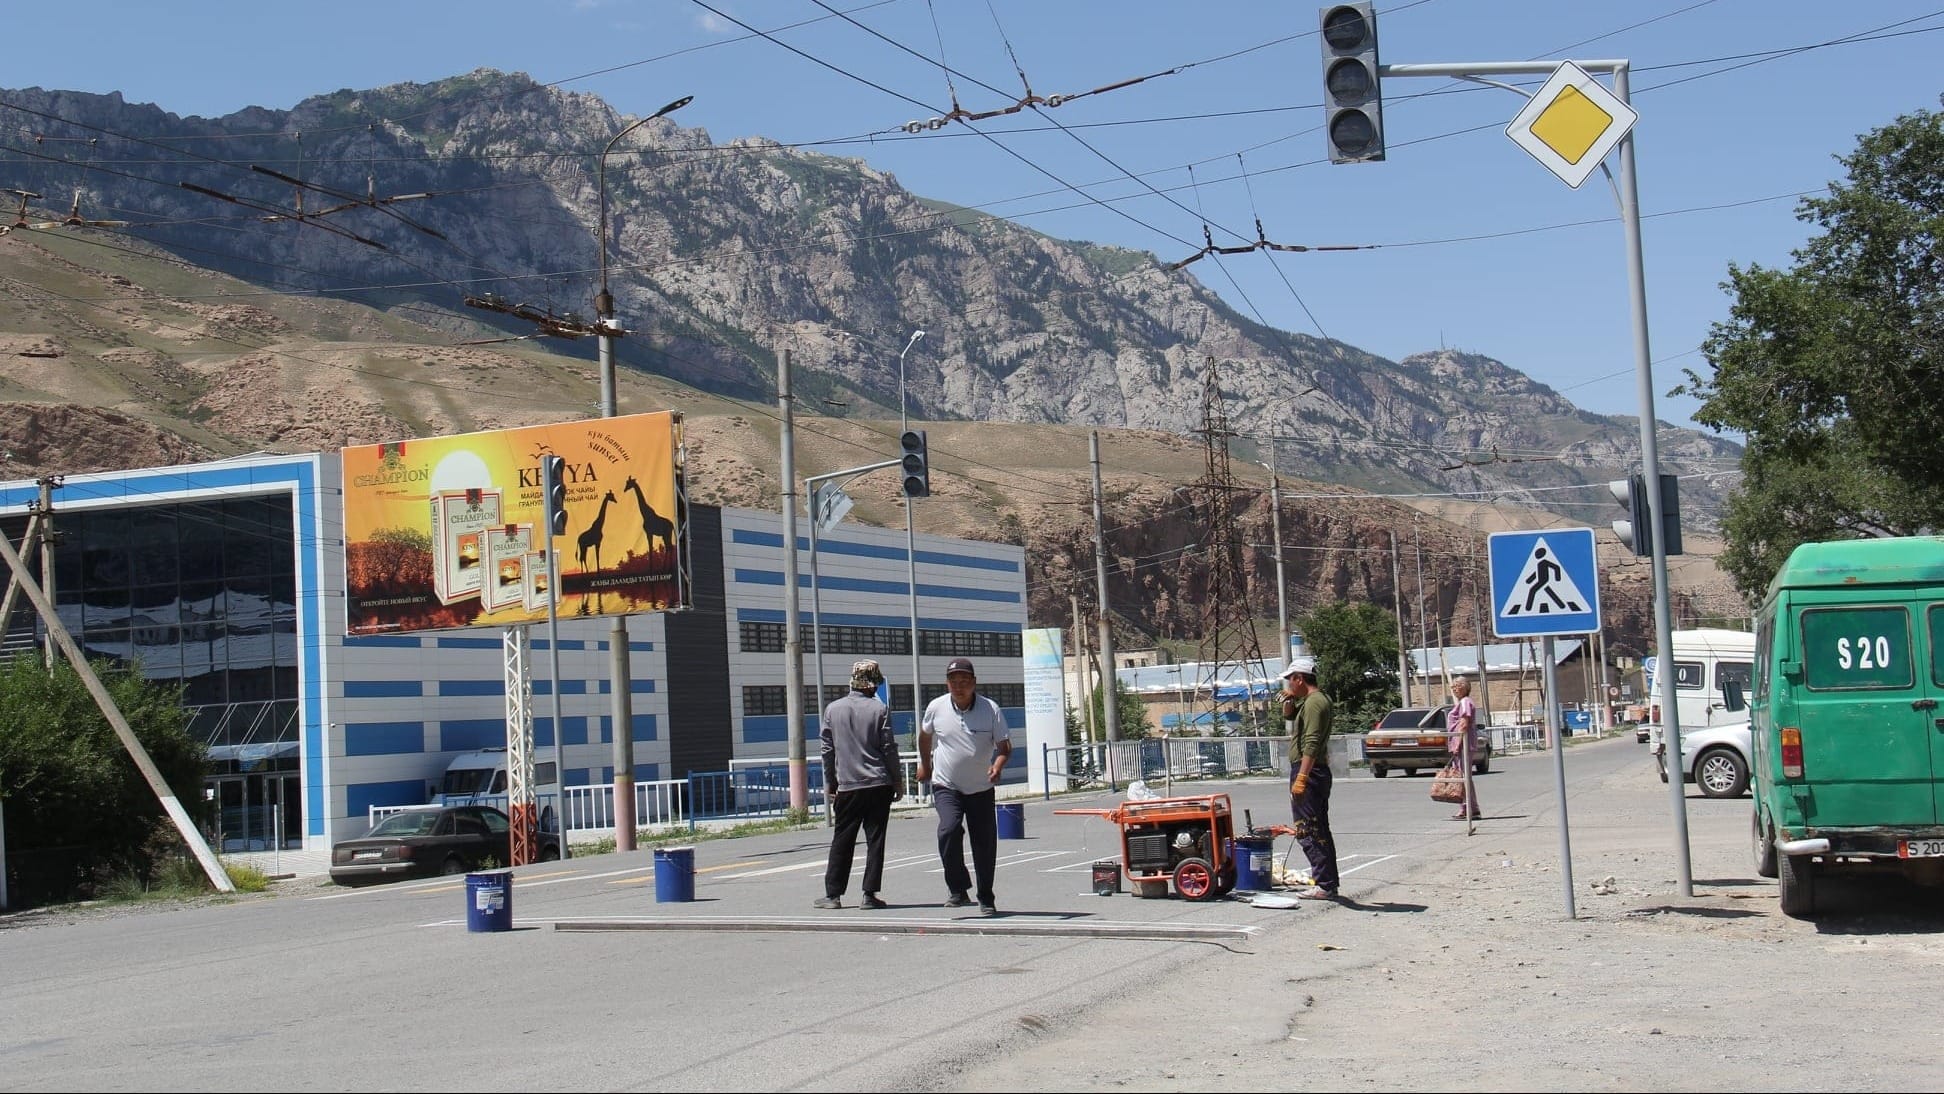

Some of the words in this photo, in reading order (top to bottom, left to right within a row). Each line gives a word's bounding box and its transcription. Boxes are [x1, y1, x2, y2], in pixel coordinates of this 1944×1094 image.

[588, 441, 619, 464] sunset
[354, 468, 429, 487] CHAMPION
[518, 462, 598, 488] KEYA
[450, 511, 496, 524] CHAMPION
[1838, 637, 1852, 669] S
[1858, 636, 1889, 669] 20
[1908, 842, 1918, 855] S
